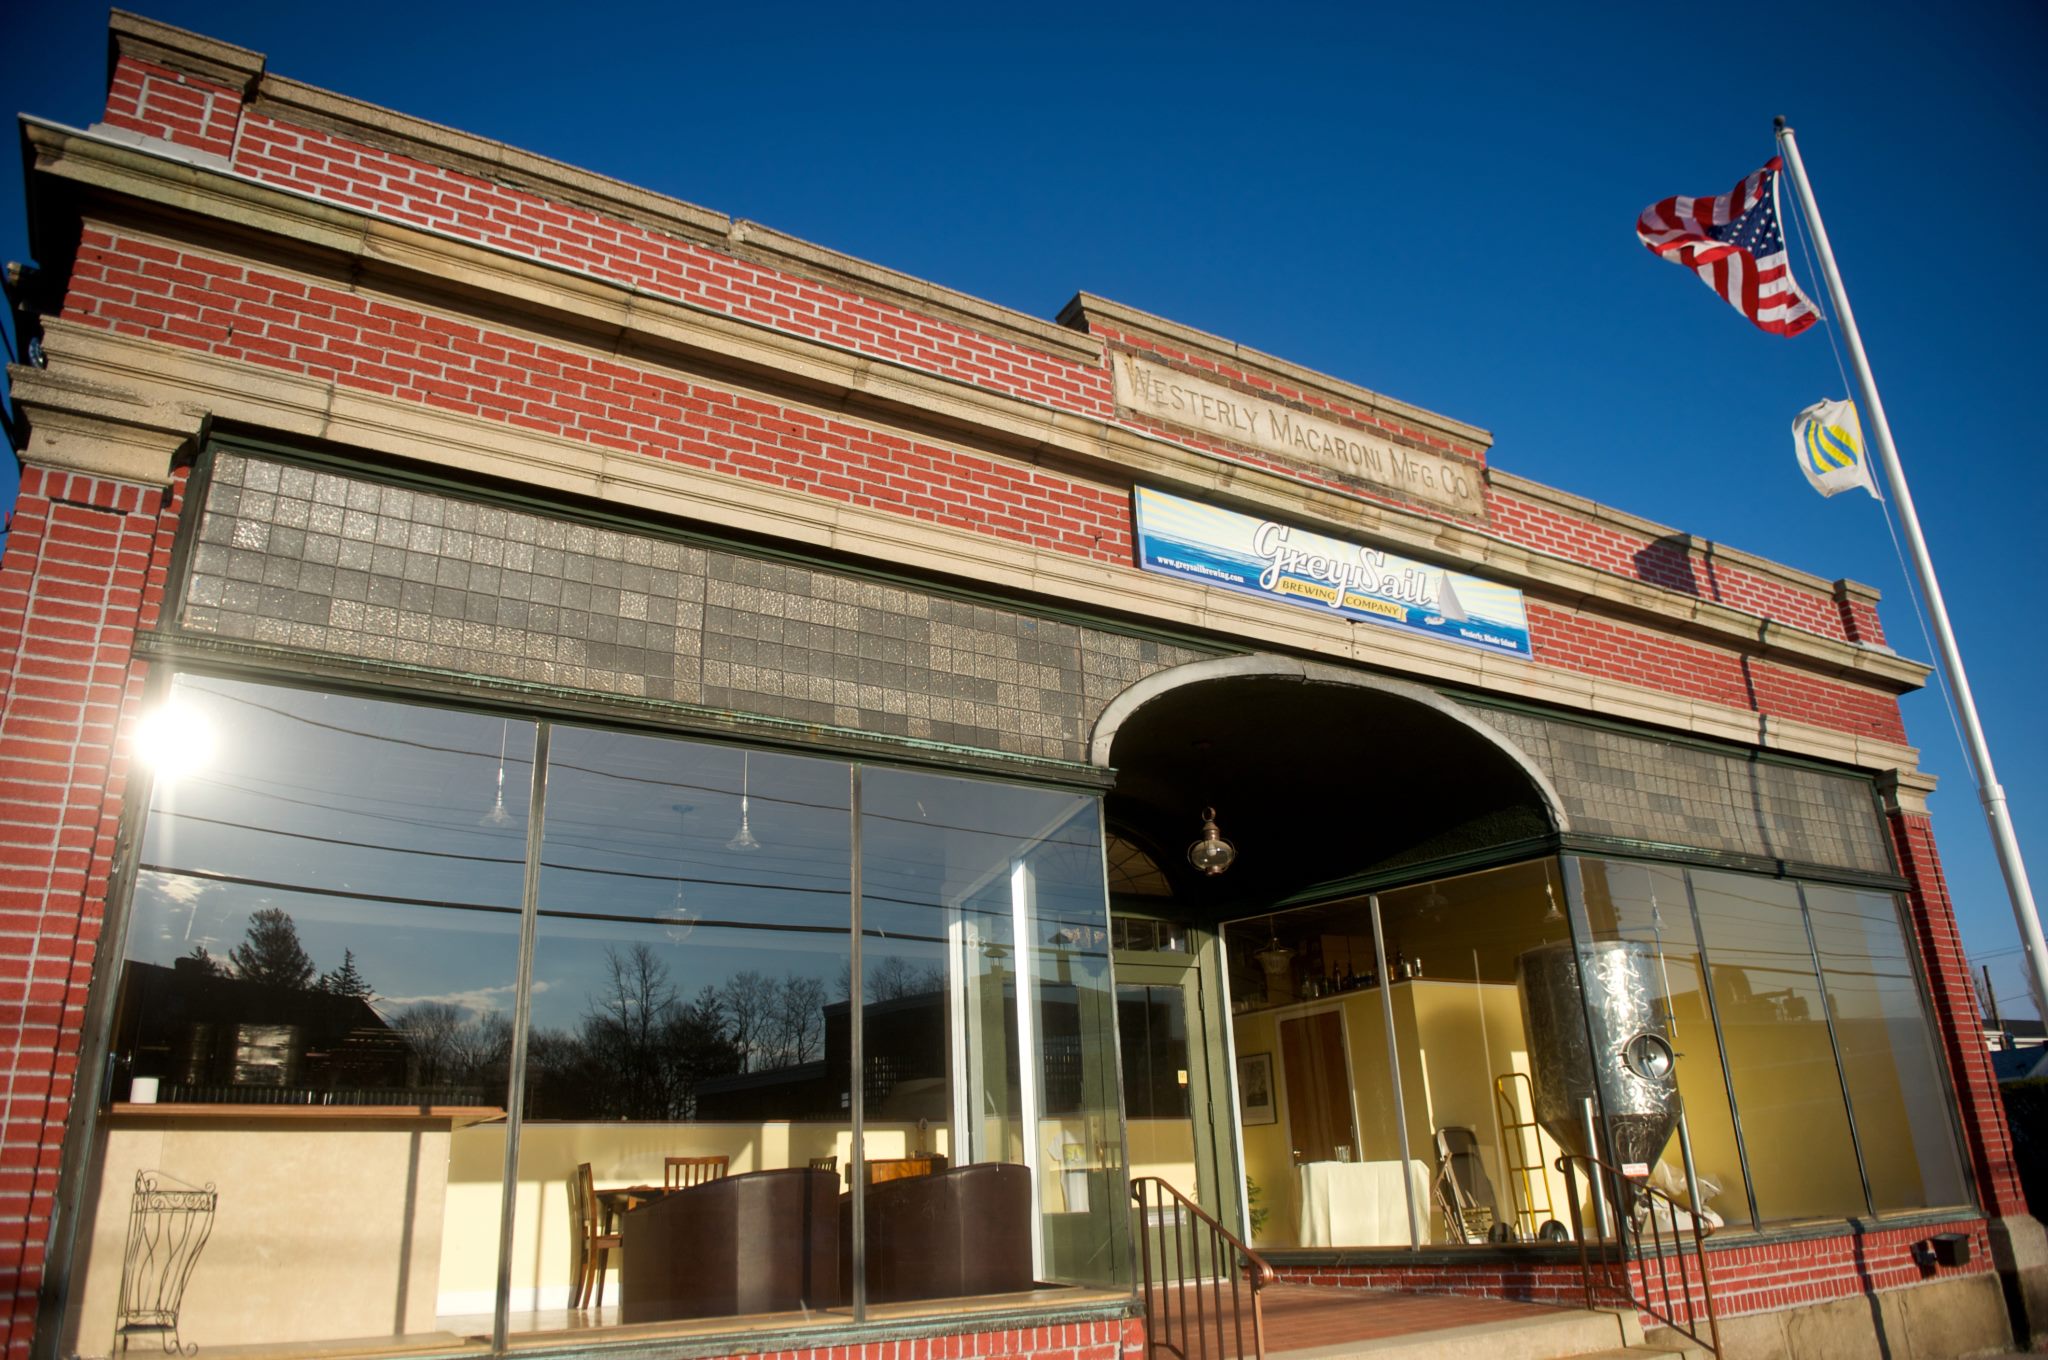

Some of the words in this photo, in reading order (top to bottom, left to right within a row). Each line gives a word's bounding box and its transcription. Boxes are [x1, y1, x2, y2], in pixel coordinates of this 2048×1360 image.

[1125, 362, 1258, 433] WESTERLY
[1268, 409, 1383, 473] MACARONI
[1282, 580, 1336, 602] BREWING
[1345, 596, 1400, 616] COMPANY
